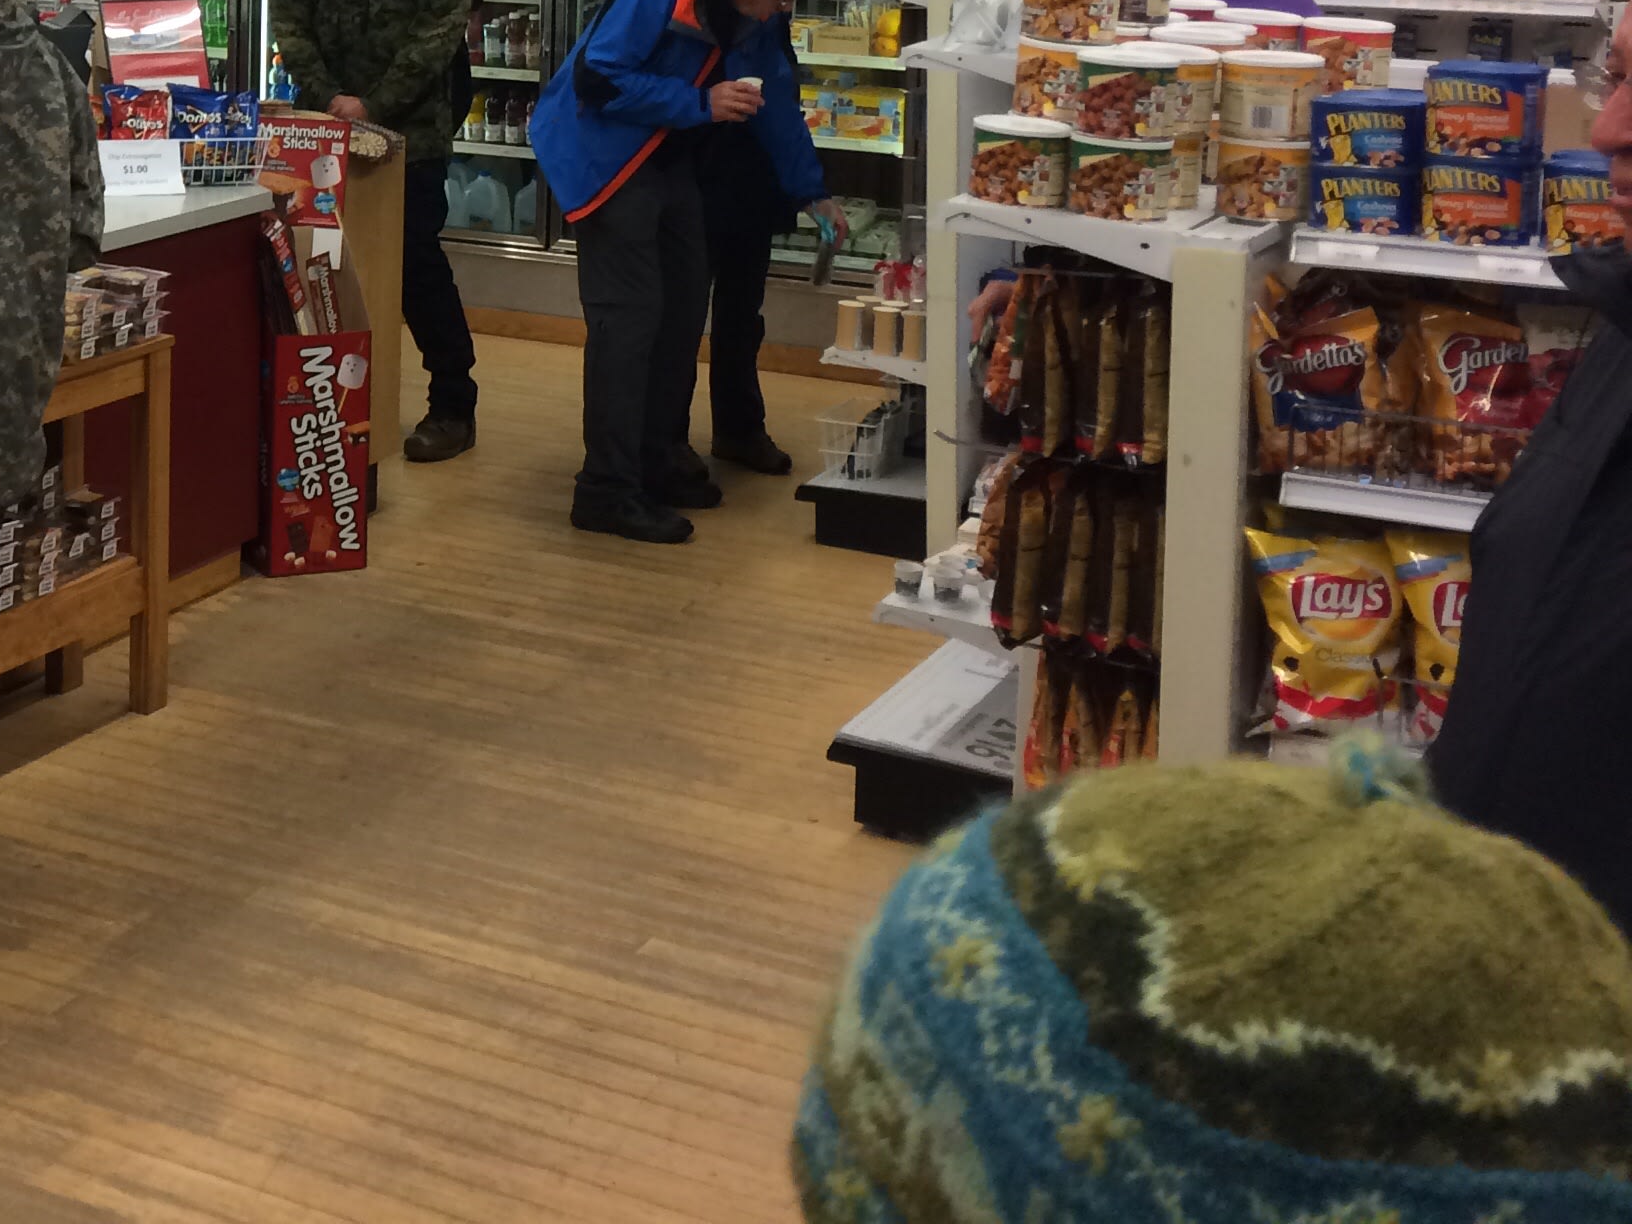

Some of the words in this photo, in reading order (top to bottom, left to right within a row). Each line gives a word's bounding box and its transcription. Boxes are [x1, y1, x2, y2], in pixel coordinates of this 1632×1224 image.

[177, 110, 223, 125] Doritos
[1326, 111, 1406, 136] PLANTERS
[257, 122, 345, 140] Marshmallow
[282, 136, 318, 150] Sticks
[122, 164, 149, 175] $1.00
[1320, 177, 1401, 201] PLANTERS
[1544, 177, 1612, 202] PLANTE
[290, 412, 323, 500] Sticks
[299, 345, 362, 552] Marshmallow
